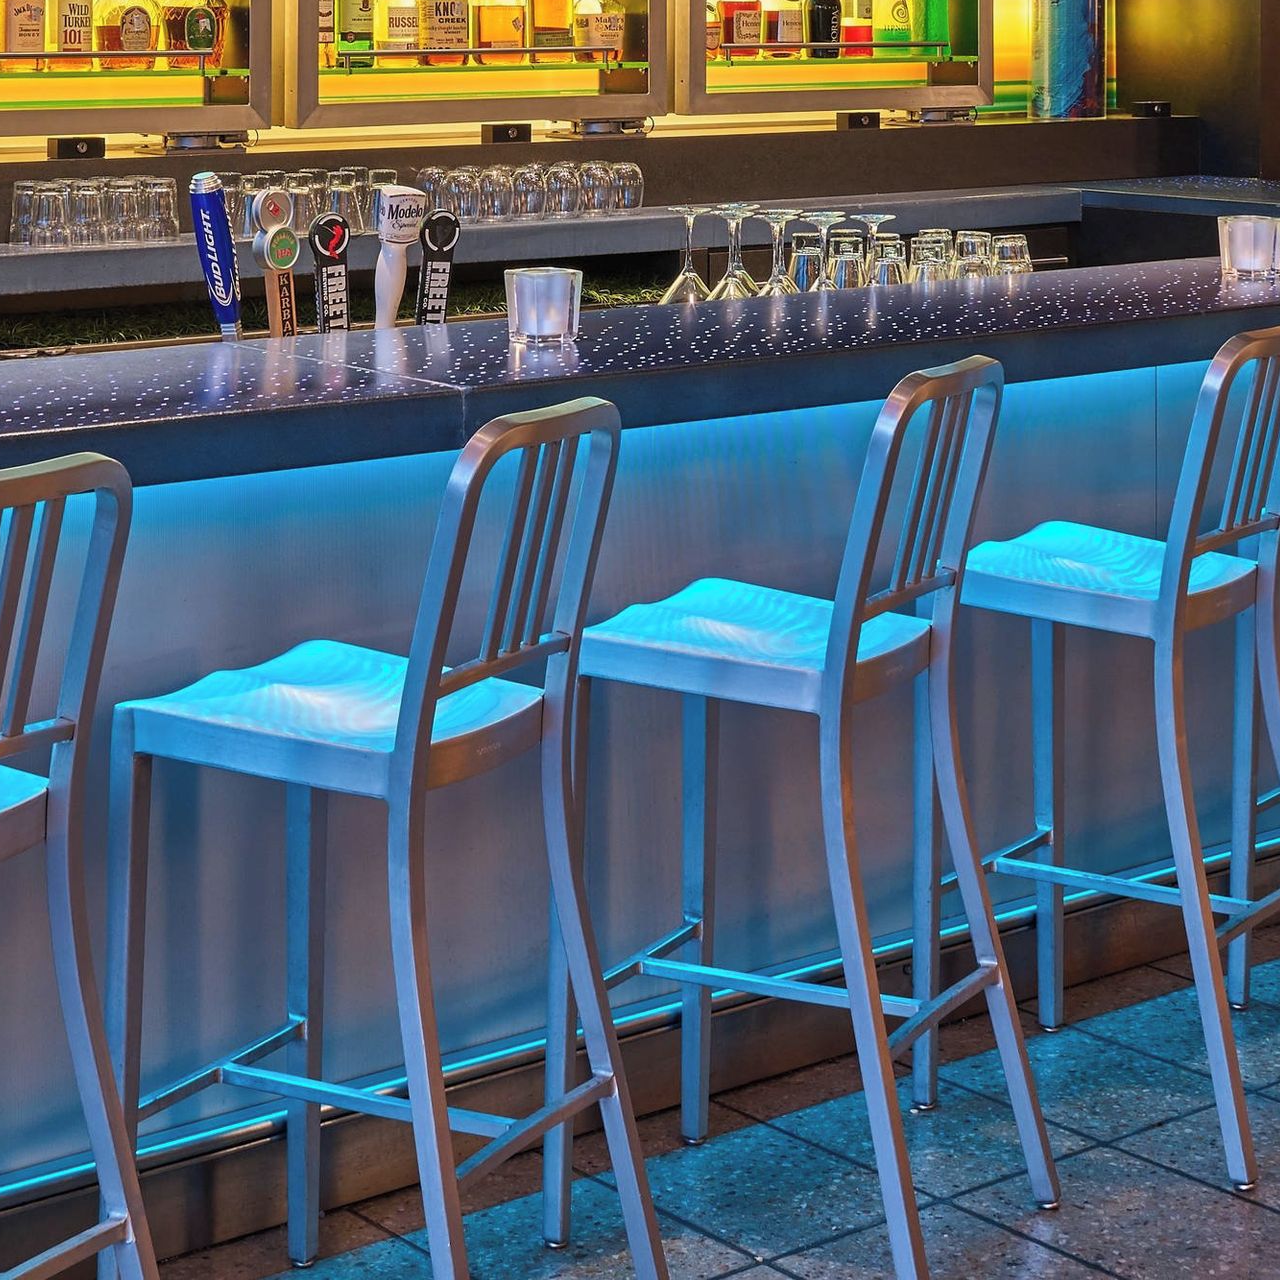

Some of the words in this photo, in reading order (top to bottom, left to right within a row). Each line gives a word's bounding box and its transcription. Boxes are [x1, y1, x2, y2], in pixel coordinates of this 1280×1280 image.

[68, 3, 89, 16] WILD
[435, 1, 462, 17] KNO
[63, 29, 82, 44] 101
[387, 203, 423, 220] Modelo
[276, 248, 293, 259] IPA
[424, 261, 432, 294] BREWING
